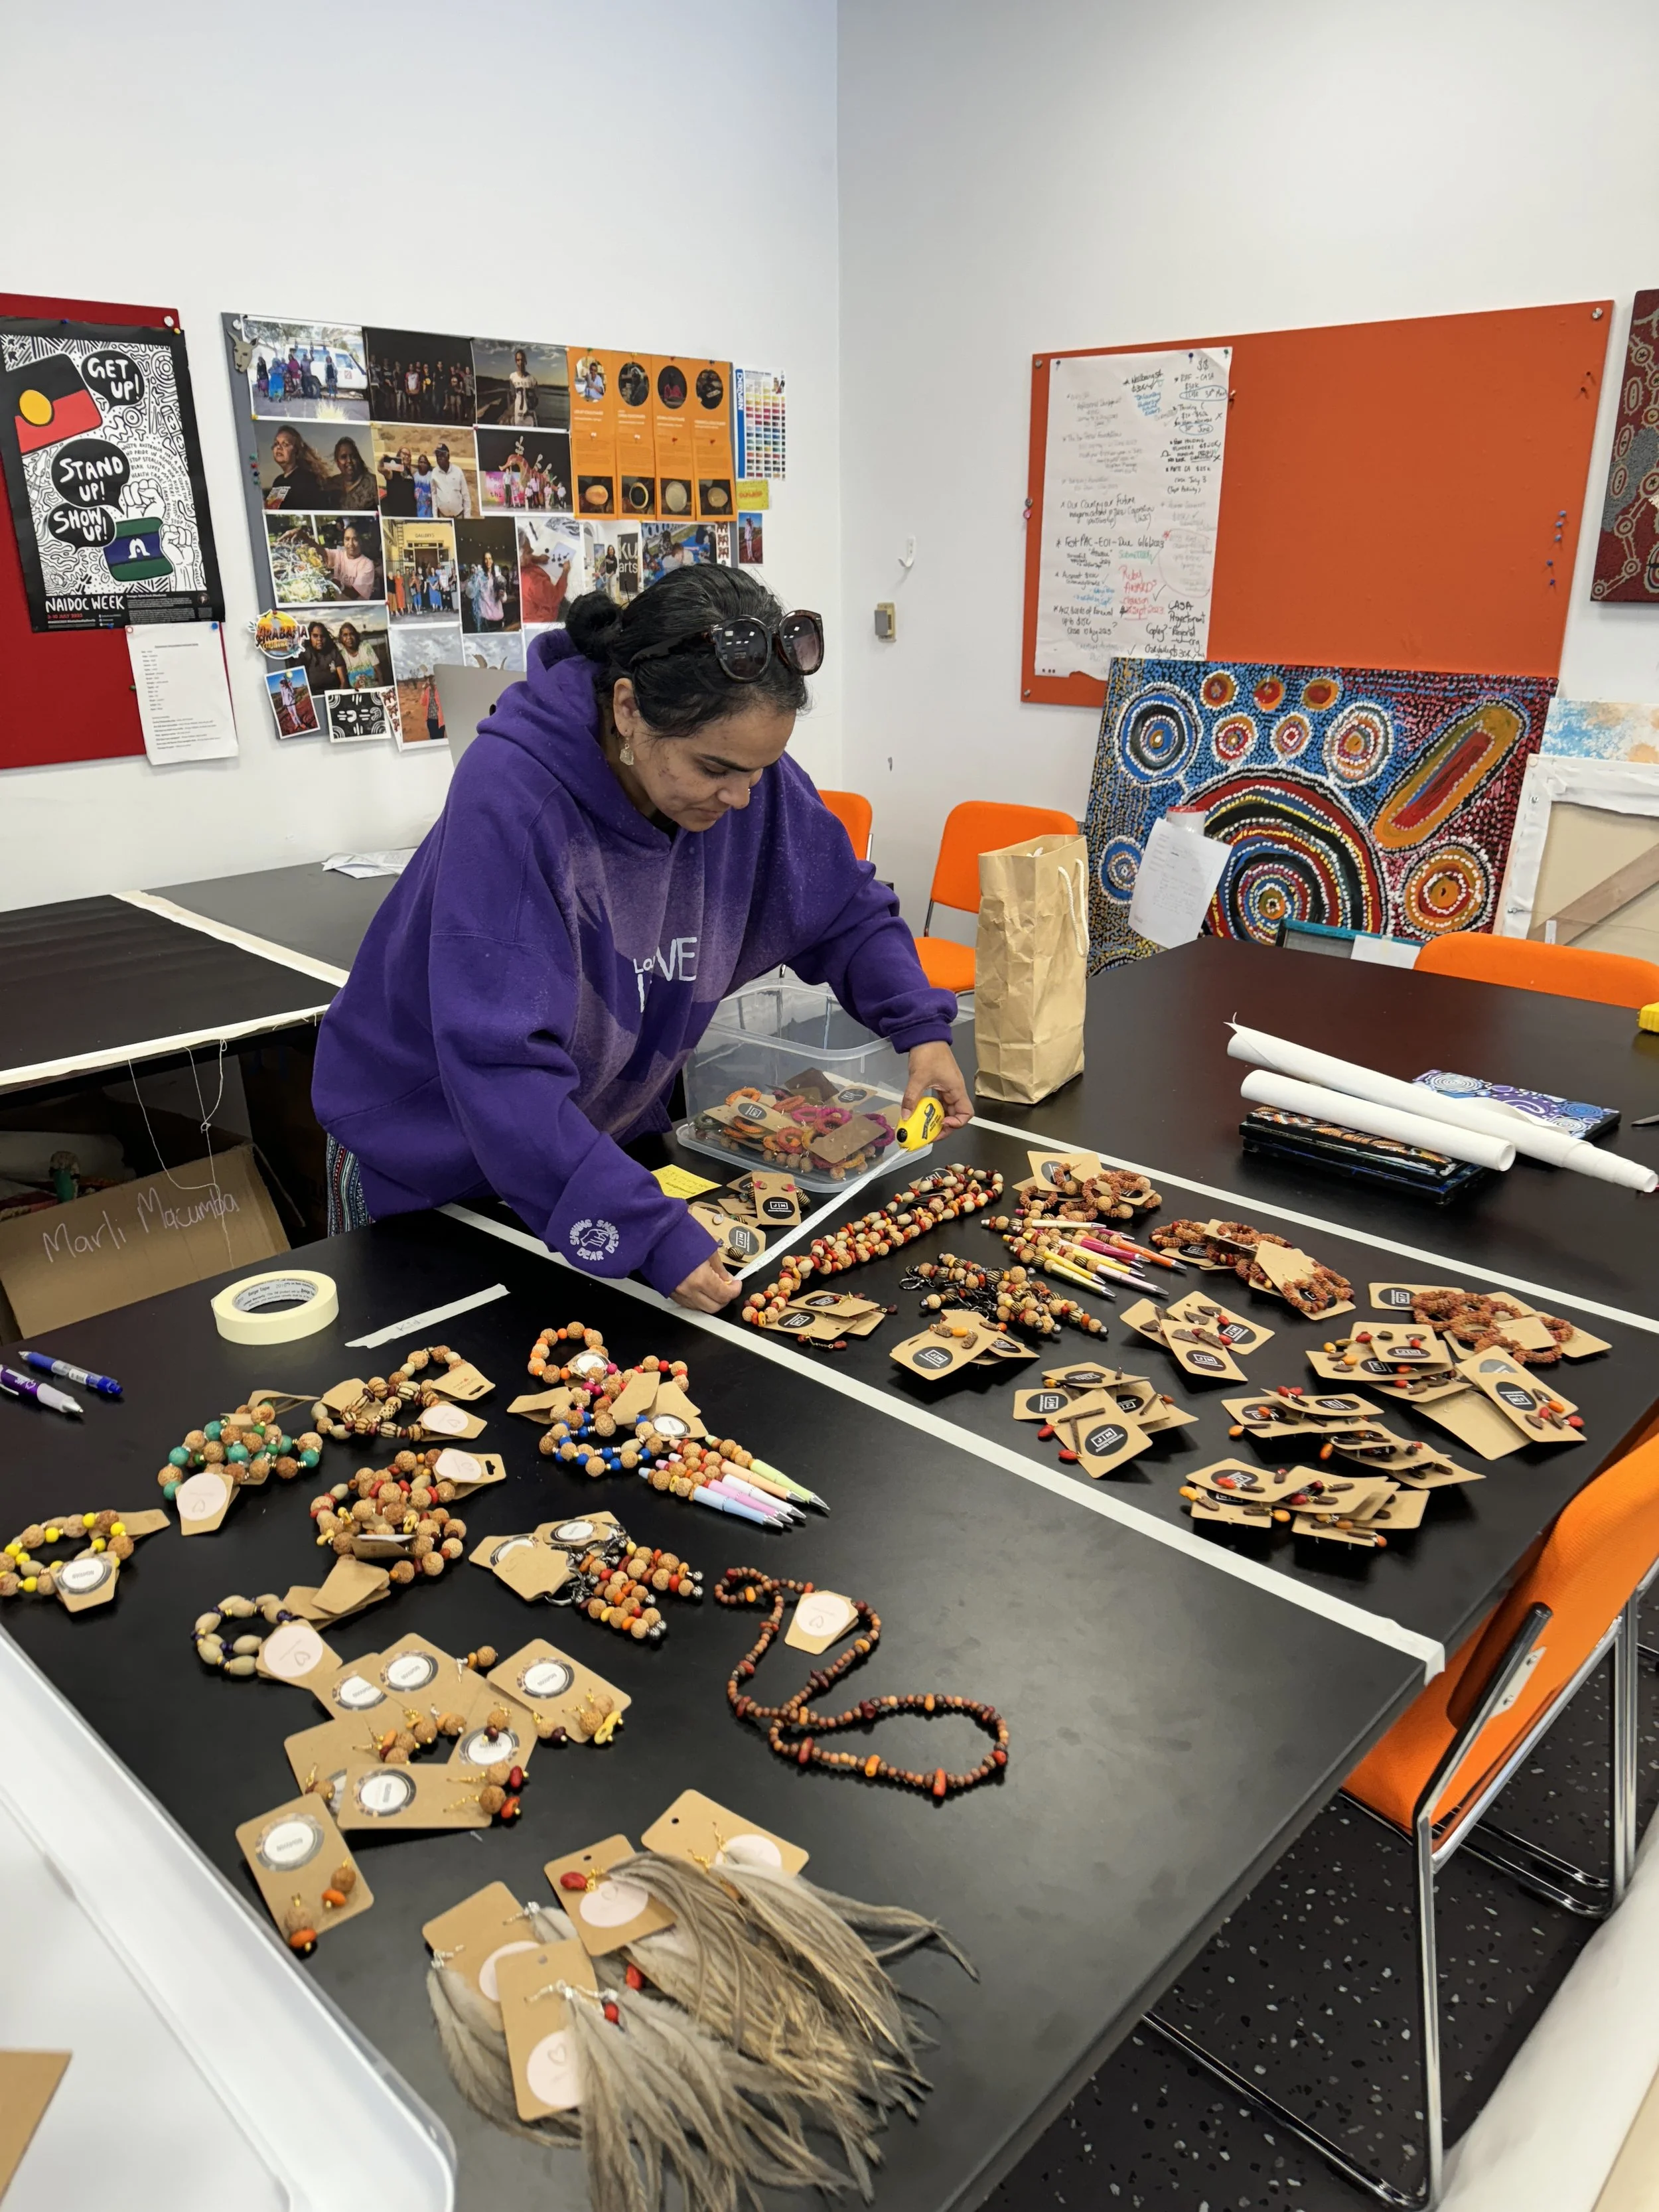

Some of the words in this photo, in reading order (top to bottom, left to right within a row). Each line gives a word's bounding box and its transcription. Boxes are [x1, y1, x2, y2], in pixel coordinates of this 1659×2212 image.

[88, 358, 128, 379] GET
[111, 374, 140, 400] UP!
[59, 456, 123, 483] STAND
[143, 457, 165, 469] STEALING
[79, 480, 105, 502] UP!
[53, 507, 102, 534] SHOW
[83, 516, 108, 542] UP!
[184, 522, 194, 530] THE
[619, 561, 638, 573] arts
[45, 597, 90, 613] NAIDOC
[91, 595, 125, 610] WEEK
[42, 1210, 126, 1262] Marli
[137, 1187, 240, 1233] Macumba
[577, 1247, 604, 1261] DEAR
